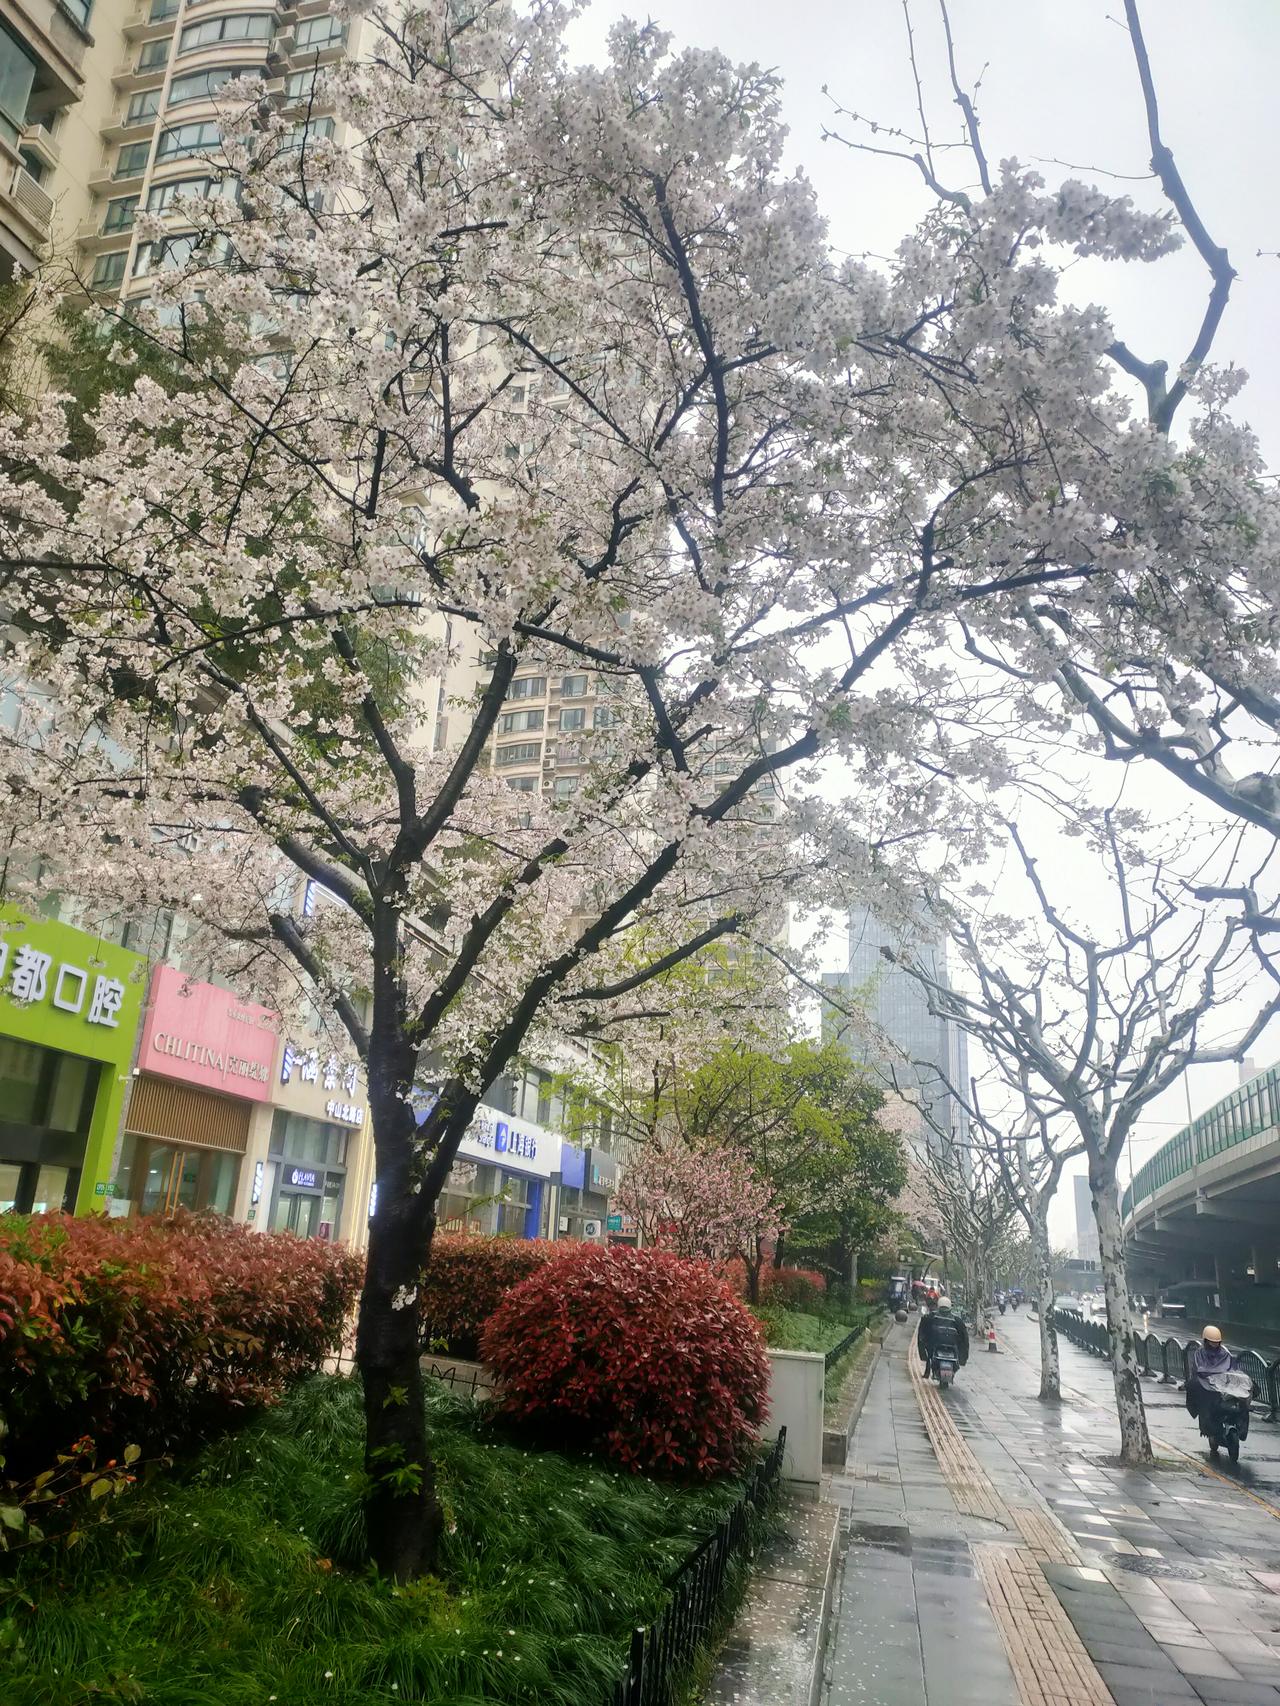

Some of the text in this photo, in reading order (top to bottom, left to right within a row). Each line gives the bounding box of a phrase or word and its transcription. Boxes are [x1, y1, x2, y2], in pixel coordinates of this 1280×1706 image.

[0, 943, 125, 1028] 都口腔
[153, 1031, 224, 1073] CHLITINA
